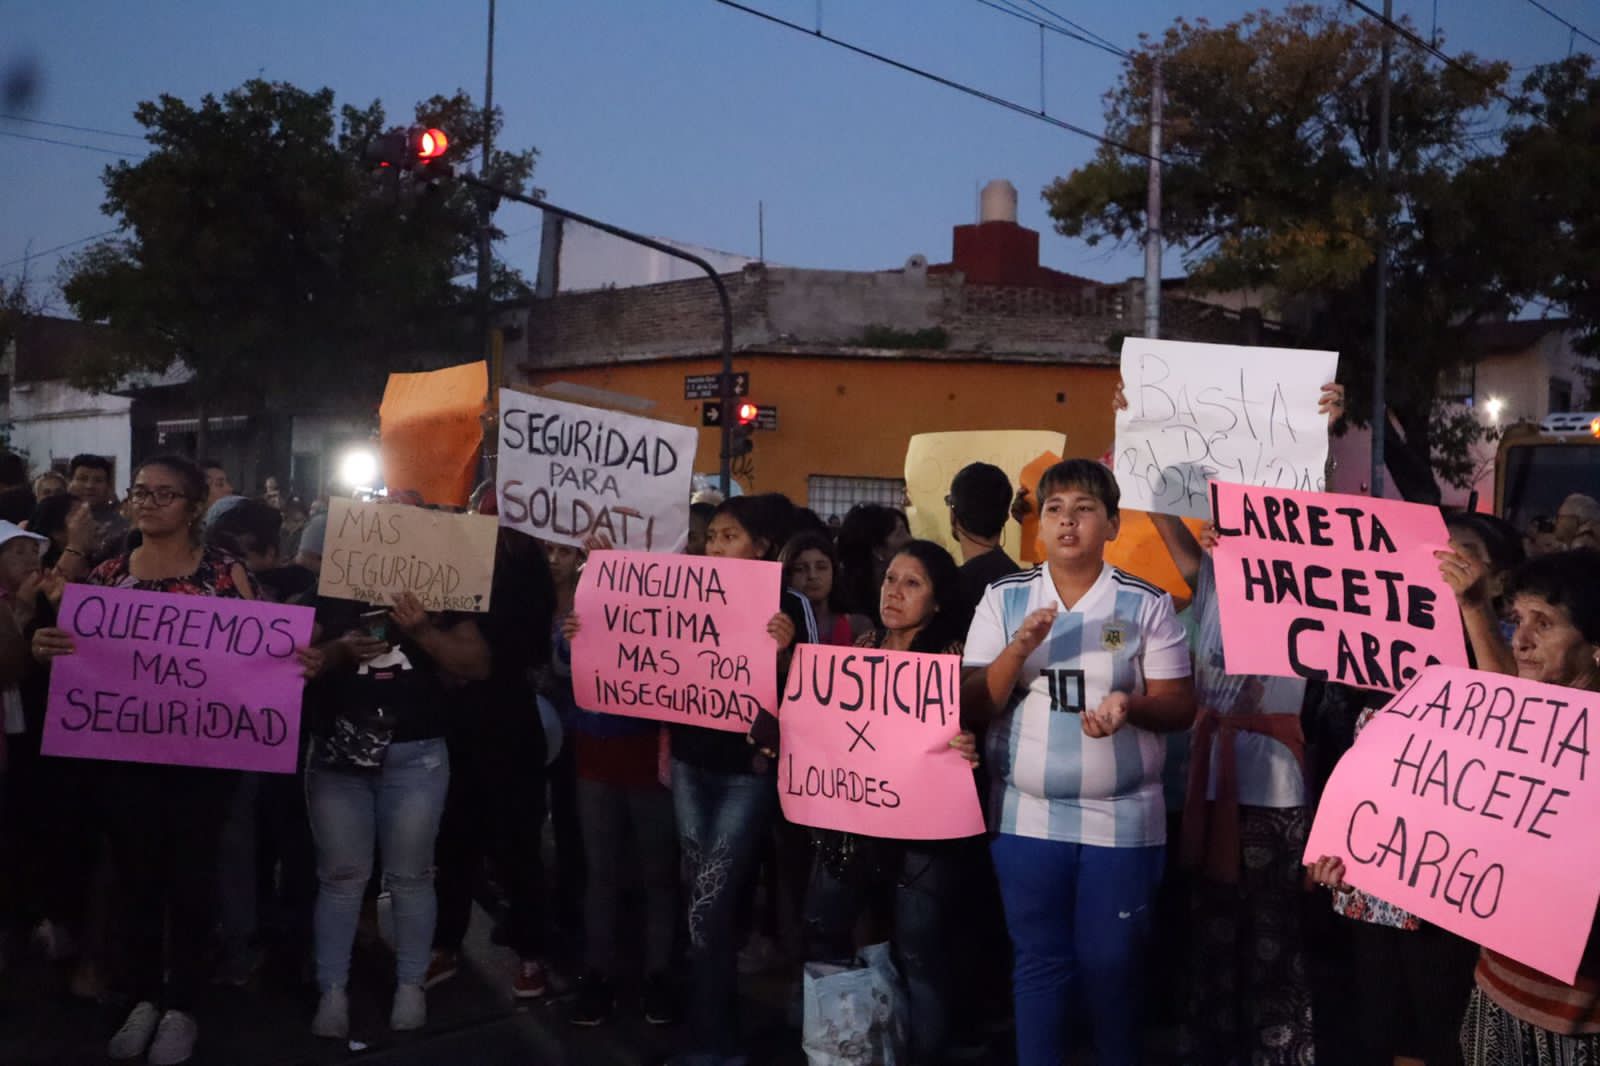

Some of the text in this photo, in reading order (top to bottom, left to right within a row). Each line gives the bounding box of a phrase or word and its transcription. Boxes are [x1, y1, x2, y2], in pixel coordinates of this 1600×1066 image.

[1129, 353, 1297, 449] BASTA
[503, 409, 678, 477] SEGURIDAD
[550, 462, 621, 499] PARA
[338, 508, 403, 545] MAS
[502, 480, 656, 552] SOLDATI
[1211, 483, 1398, 553] LARRETA
[328, 549, 461, 595] SEGURIDAD
[351, 587, 385, 602] PARA
[597, 556, 728, 605] NINGUNA
[1241, 557, 1438, 631] HACETE
[73, 595, 296, 659] QUEREMOS
[604, 604, 721, 647] VICTIMA
[133, 650, 208, 688] MAS
[617, 643, 751, 686] MAS POR
[1040, 669, 1085, 713] 10
[61, 688, 288, 747] SEGURIDAD
[845, 721, 876, 752] X
[1386, 674, 1590, 781] LARRETA
[787, 753, 901, 808] LOURDES
[1392, 734, 1571, 839] HACETE
[1347, 800, 1505, 919] CARGO
